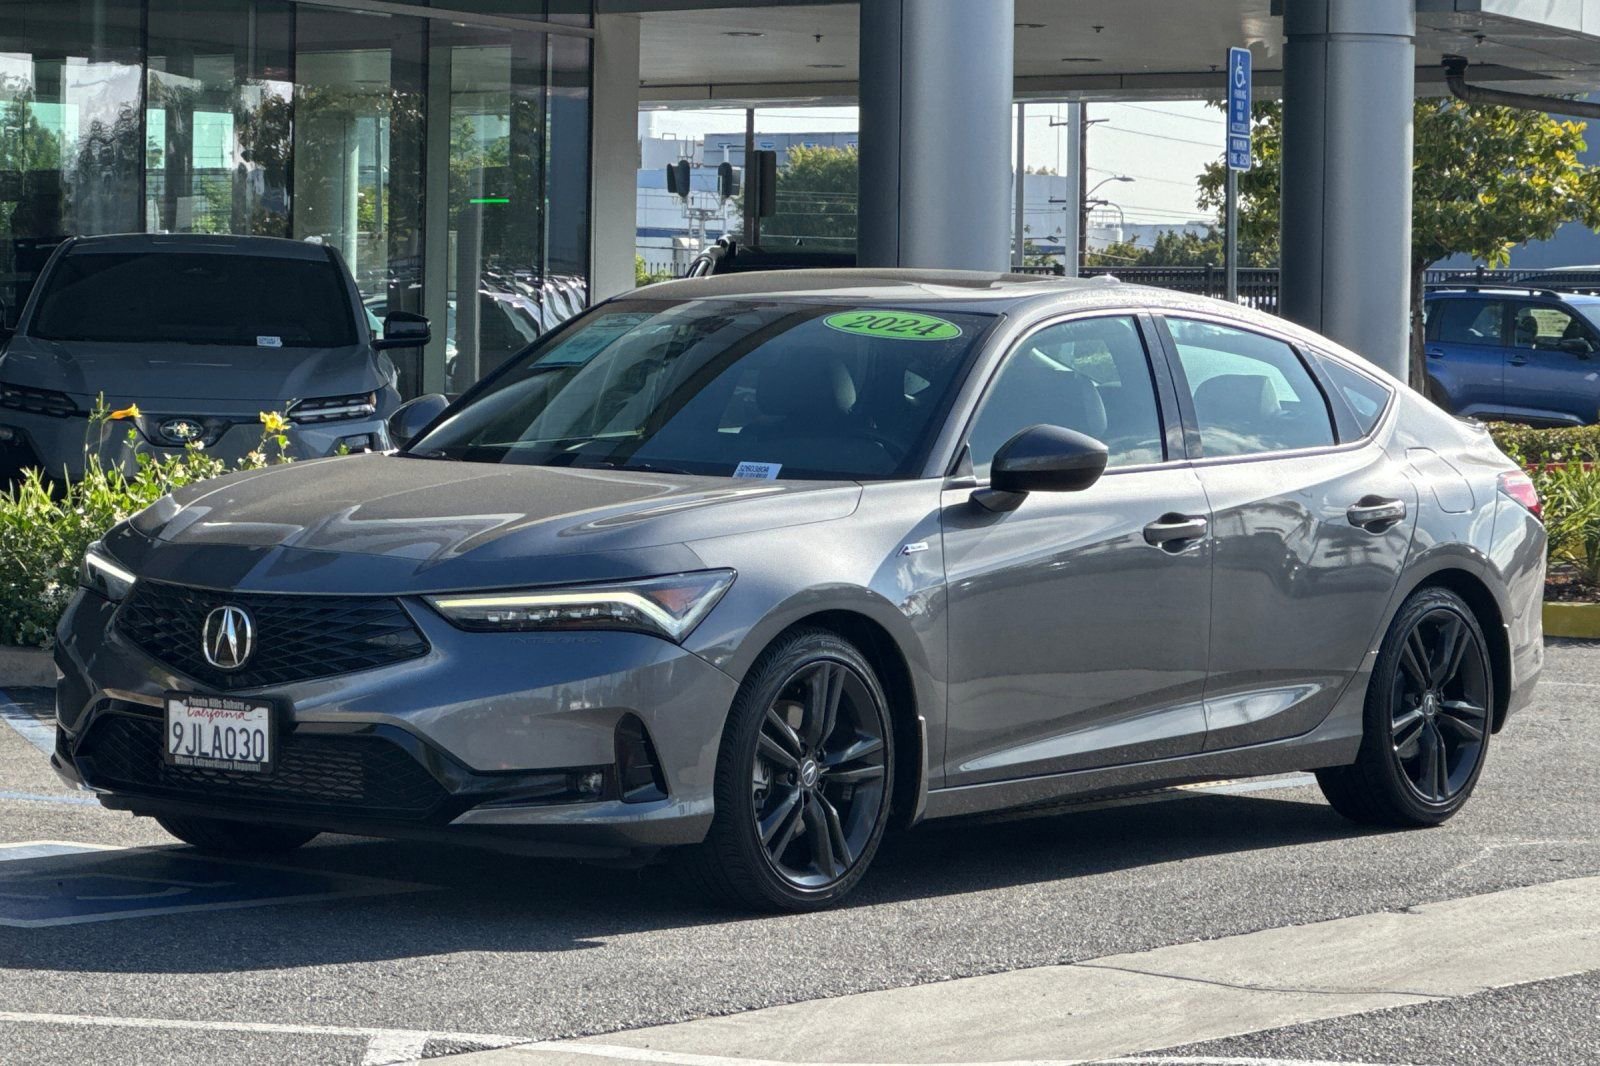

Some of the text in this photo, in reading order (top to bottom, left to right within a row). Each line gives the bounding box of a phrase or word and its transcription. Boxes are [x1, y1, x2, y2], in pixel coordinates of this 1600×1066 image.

[842, 315, 944, 336] 2024
[208, 698, 222, 709] Hills
[223, 699, 245, 711] Subaru
[187, 706, 252, 724] California
[172, 722, 265, 763] 9JLA030
[174, 755, 193, 766] Where
[193, 757, 233, 770] Extraordinary
